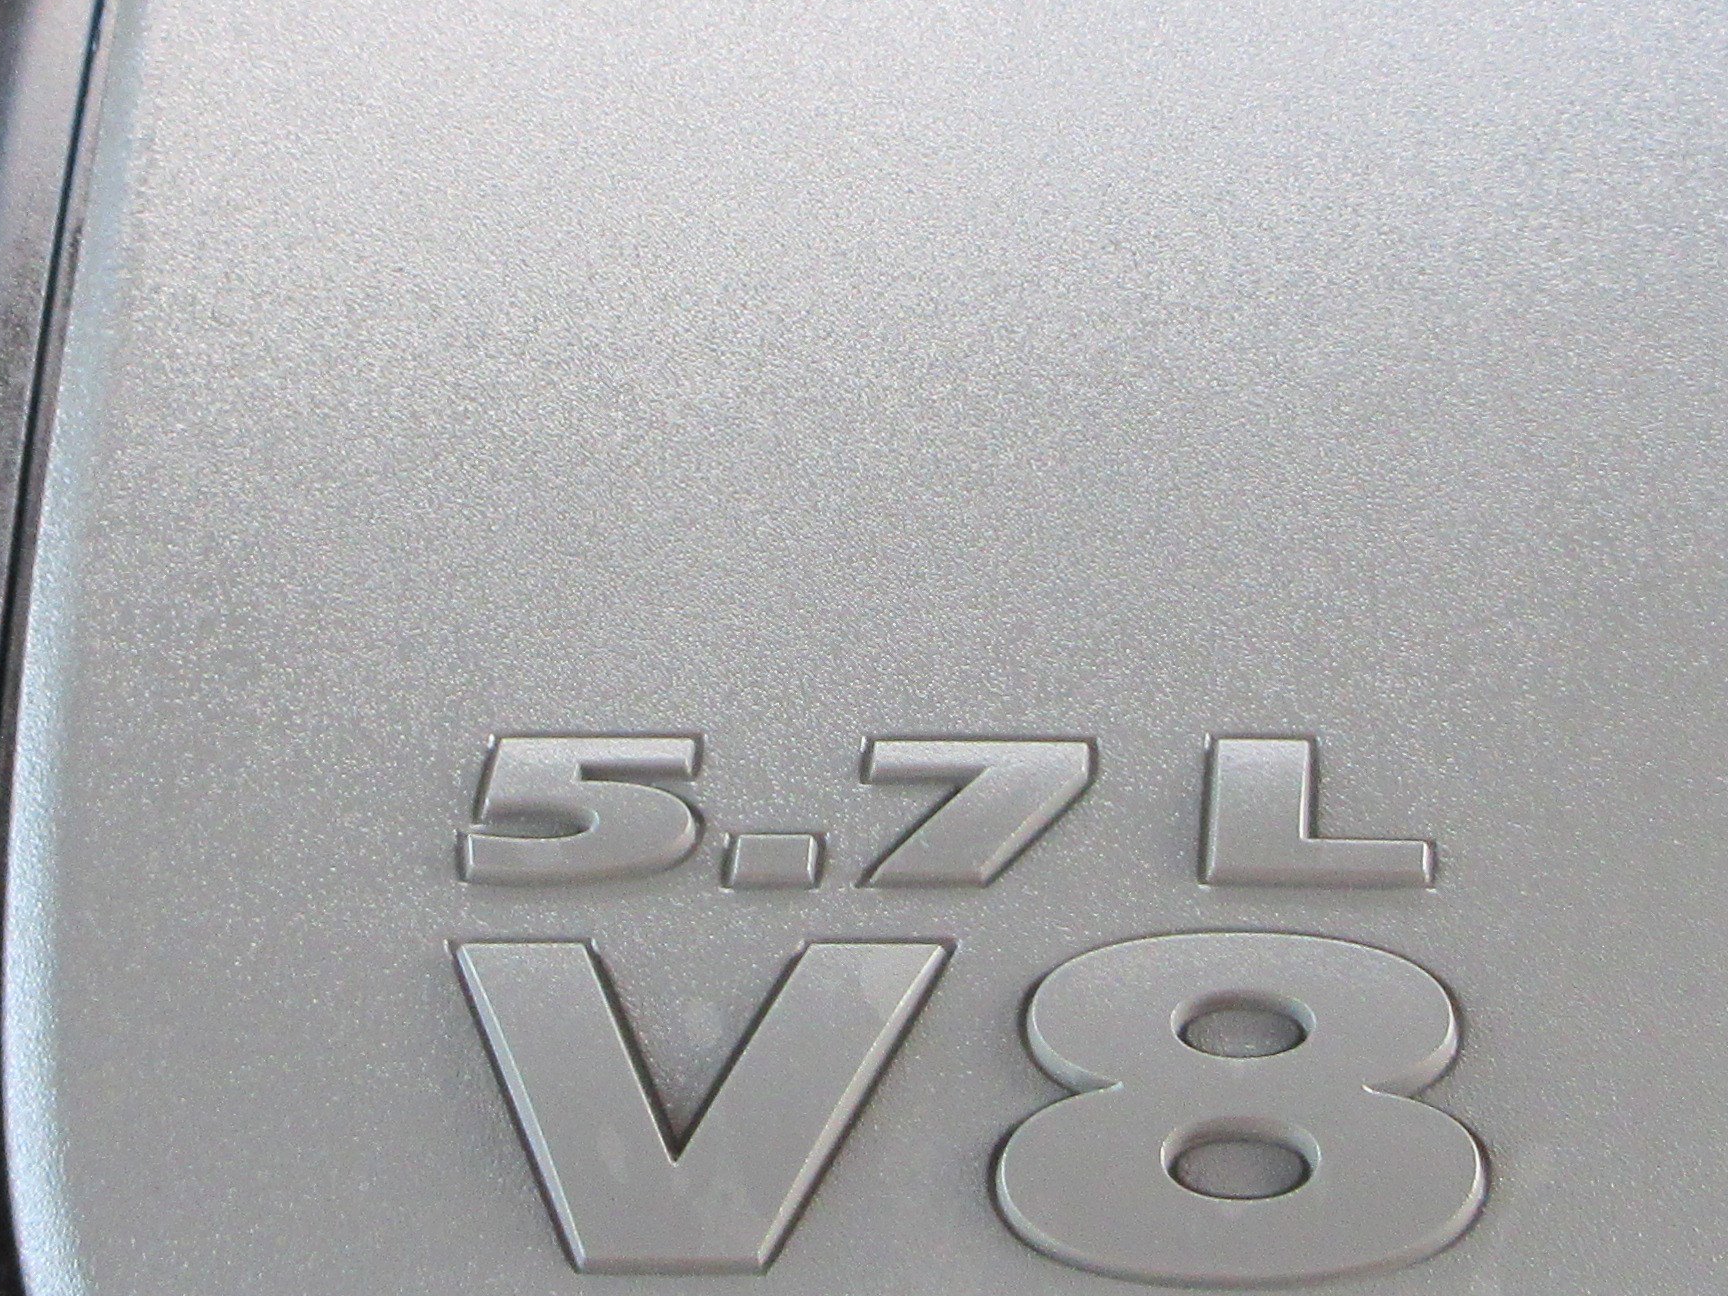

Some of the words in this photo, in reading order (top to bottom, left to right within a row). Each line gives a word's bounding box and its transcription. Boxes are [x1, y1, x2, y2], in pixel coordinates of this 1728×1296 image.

[455, 734, 1098, 888] 5.7
[1198, 734, 1437, 888] L
[445, 930, 1491, 1288] V8
